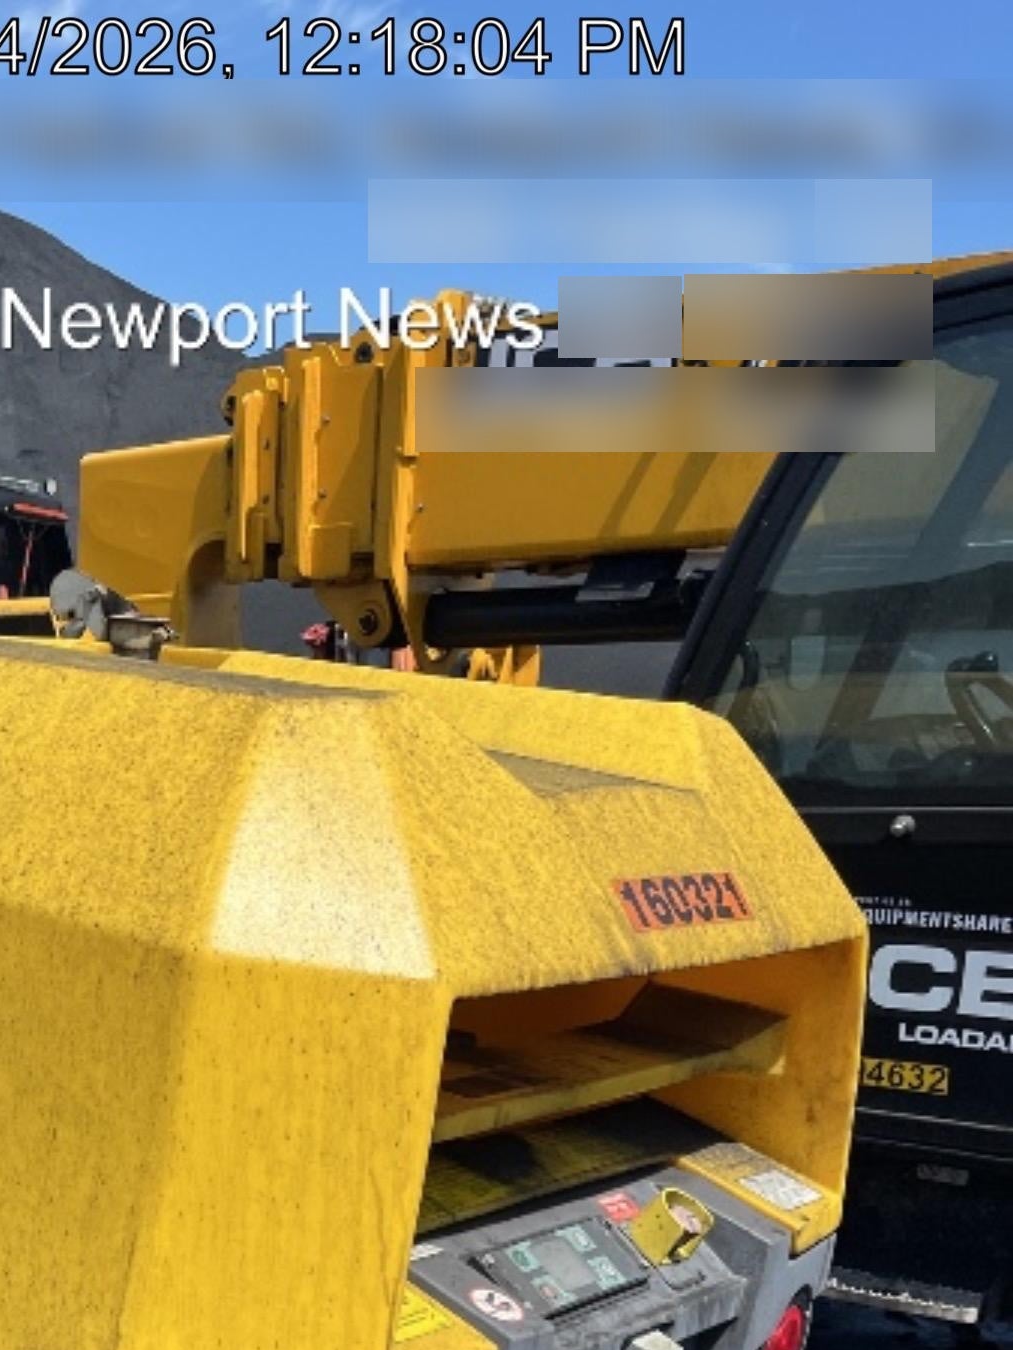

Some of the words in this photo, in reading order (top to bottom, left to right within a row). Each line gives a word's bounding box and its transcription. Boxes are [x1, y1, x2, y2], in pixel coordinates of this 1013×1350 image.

[619, 872, 749, 928] 160321
[863, 907, 1013, 935] QUIPMENTSHARE
[898, 1022, 1013, 1053] LOADA
[861, 1061, 946, 1093] 4632
